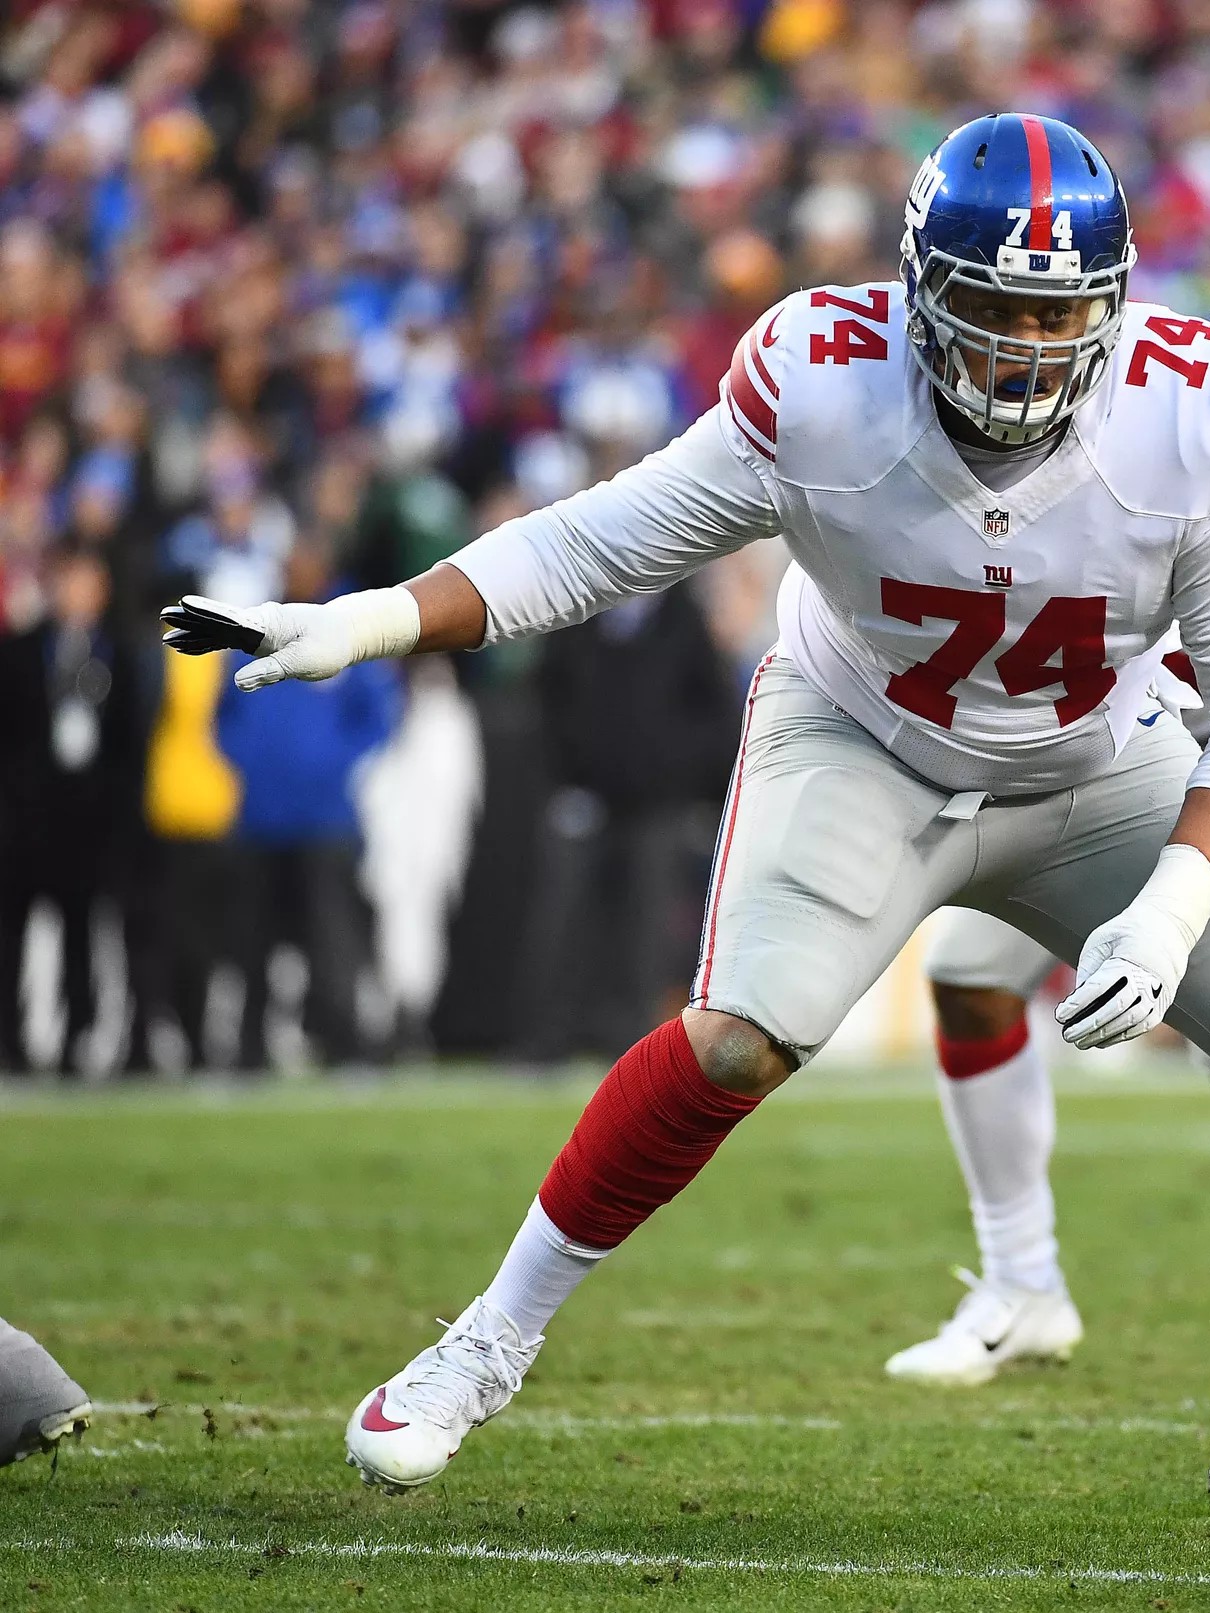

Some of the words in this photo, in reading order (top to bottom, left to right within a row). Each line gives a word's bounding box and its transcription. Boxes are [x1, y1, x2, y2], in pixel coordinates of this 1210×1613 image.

[1006, 208, 1073, 250] 74
[810, 289, 889, 366] 74
[986, 520, 1006, 534] NFL
[880, 577, 1117, 730] 74
